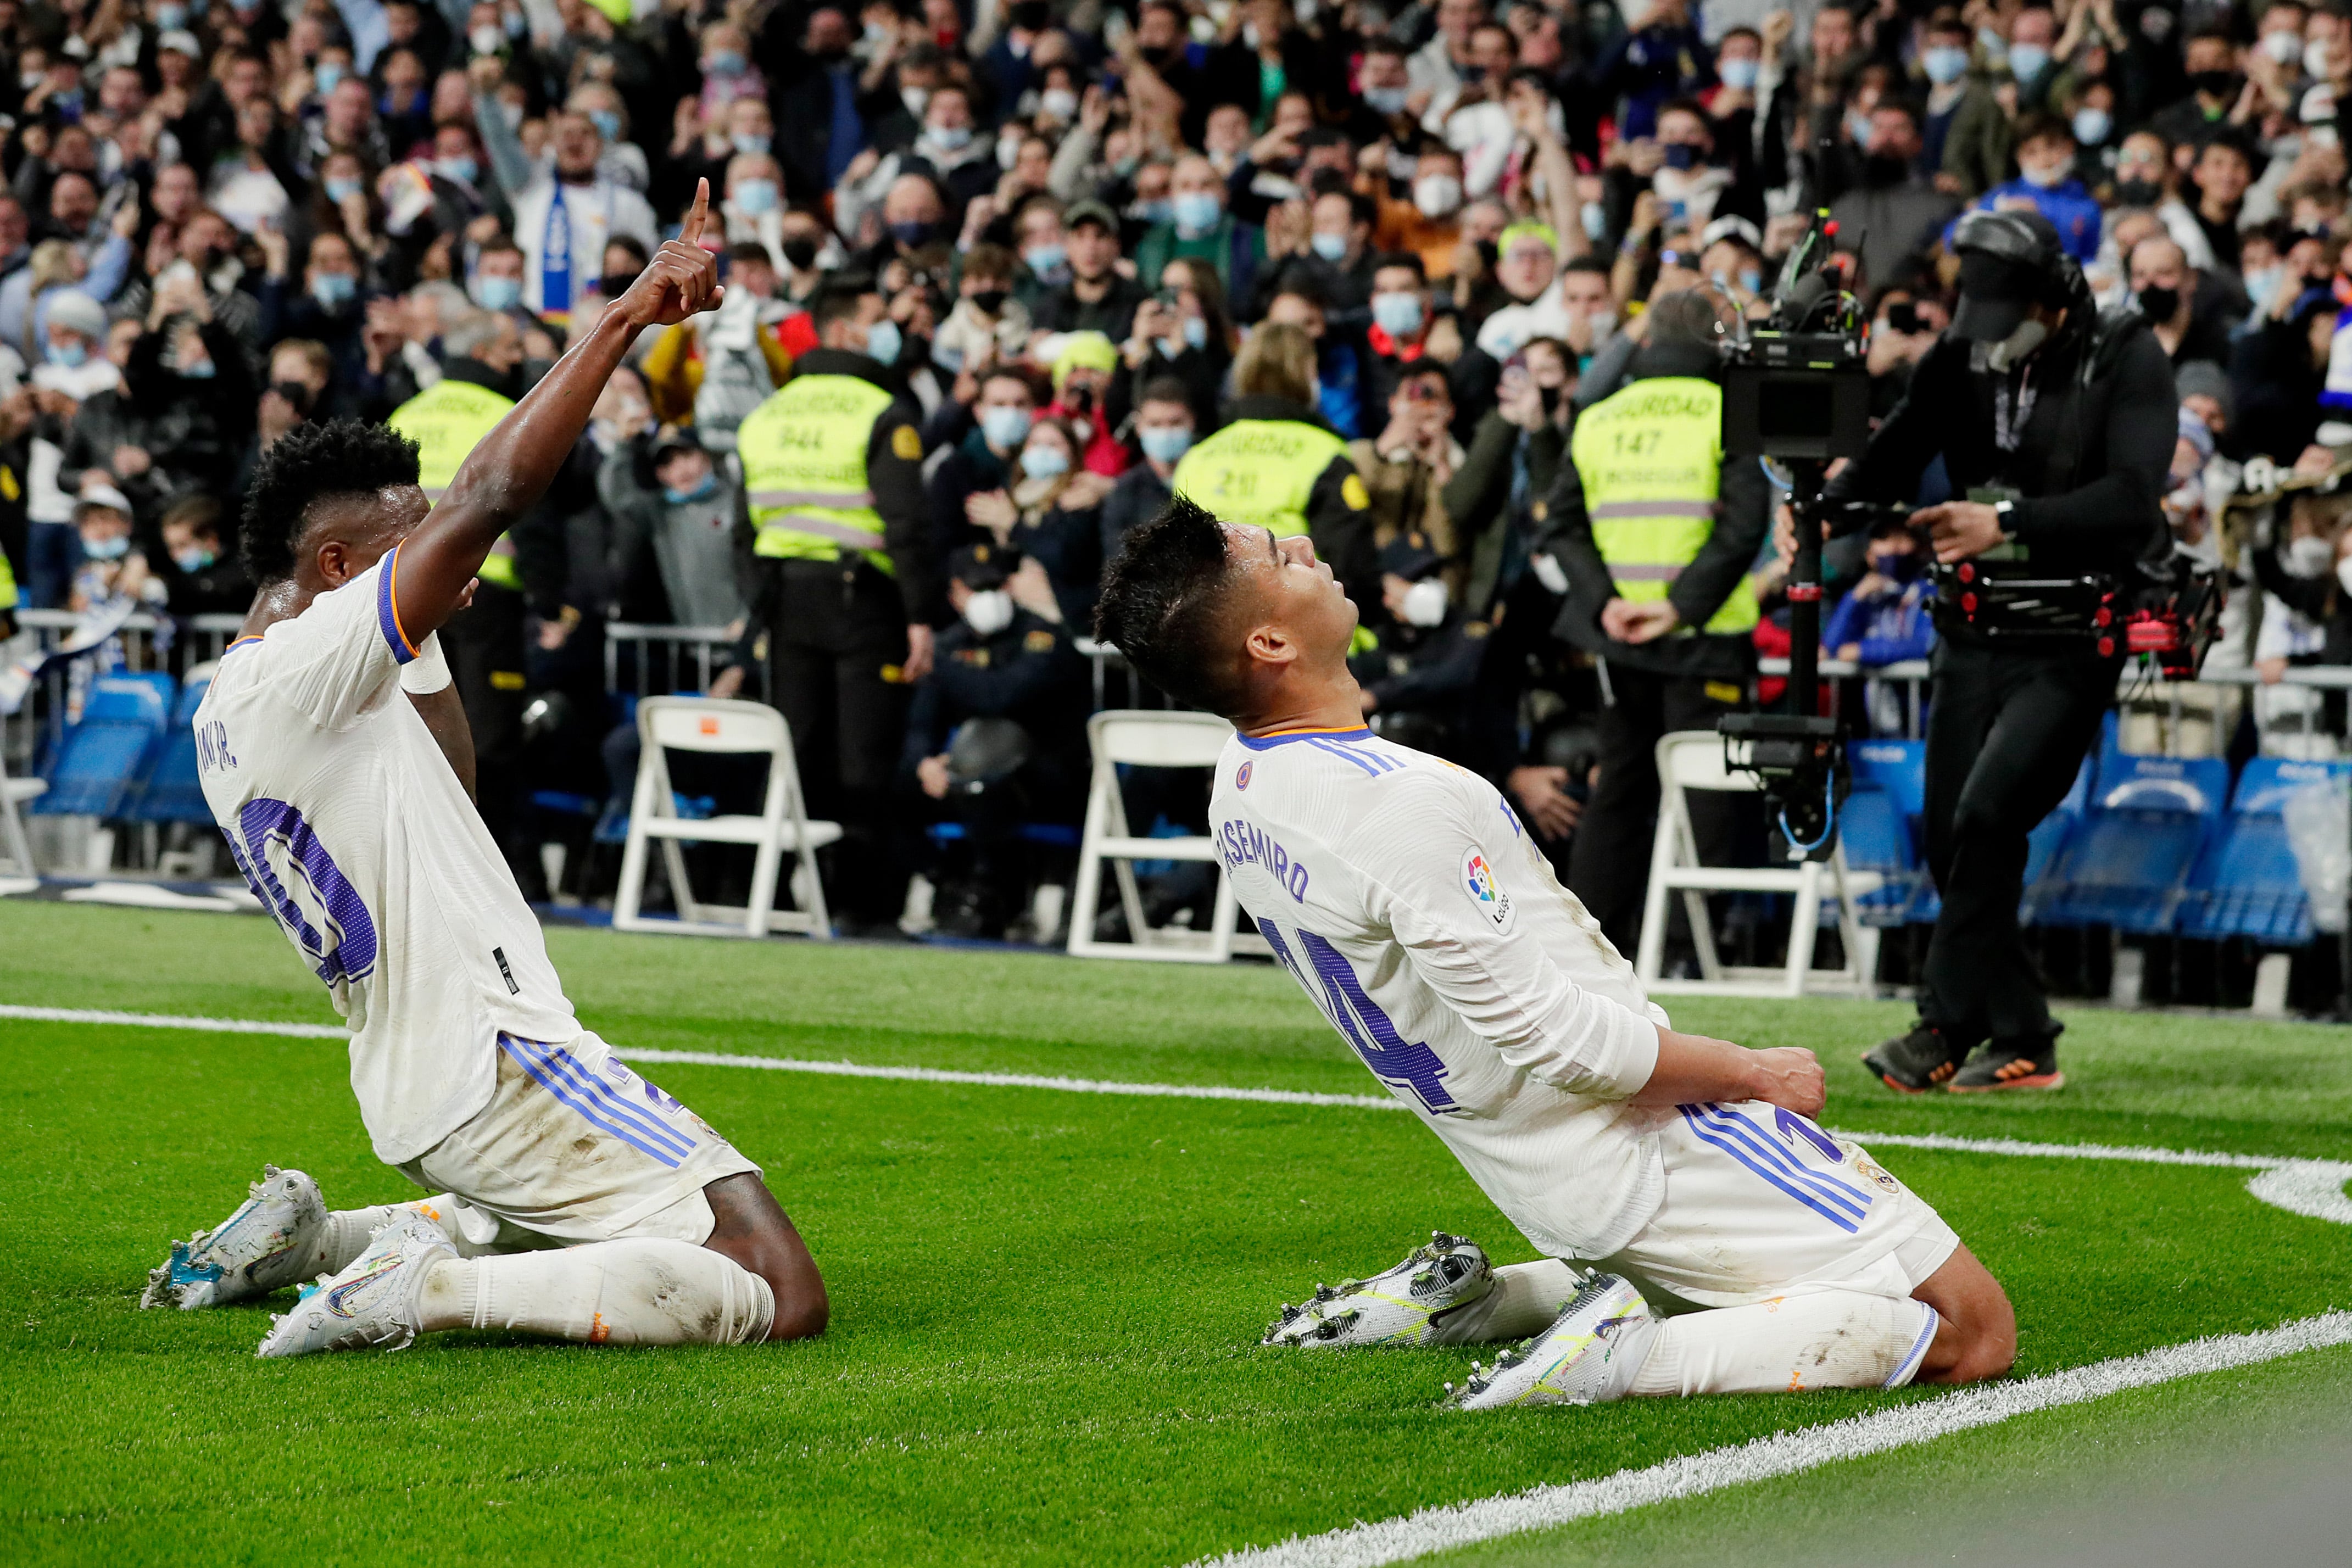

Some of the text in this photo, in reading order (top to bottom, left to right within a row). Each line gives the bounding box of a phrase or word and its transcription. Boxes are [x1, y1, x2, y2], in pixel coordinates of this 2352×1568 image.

[1614, 428, 1663, 456] 147
[1216, 819, 1309, 904] ASEMIRO
[1774, 1106, 1847, 1165] 1
